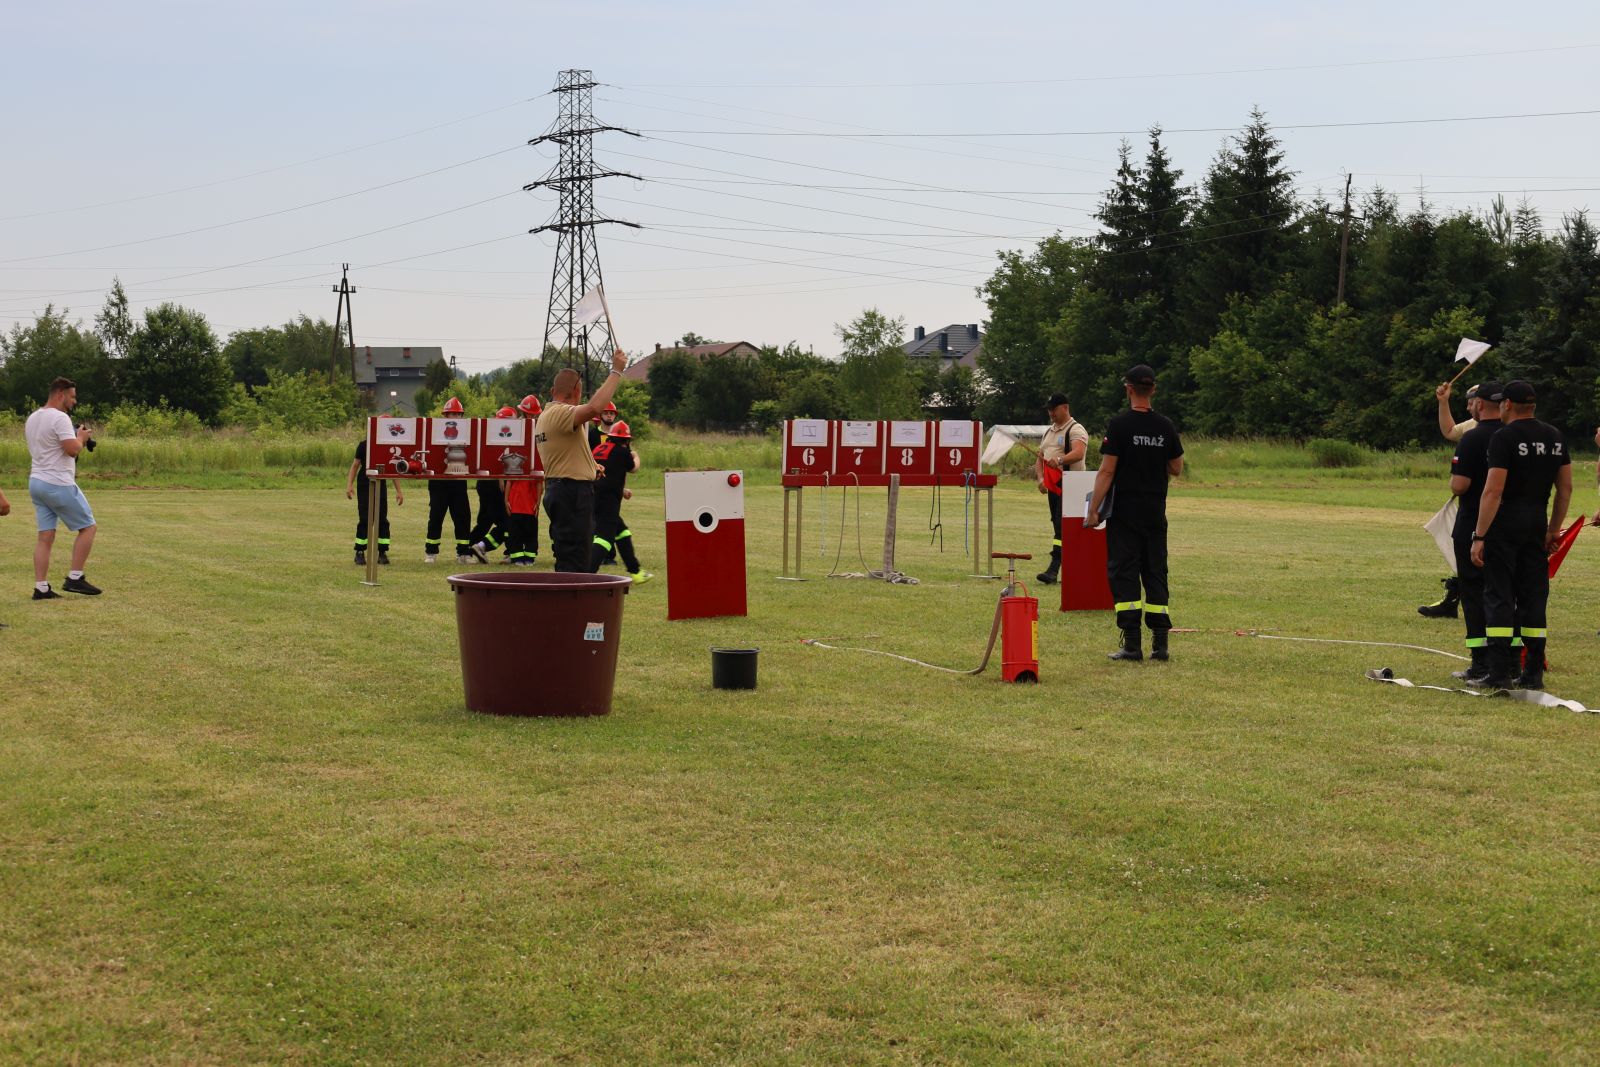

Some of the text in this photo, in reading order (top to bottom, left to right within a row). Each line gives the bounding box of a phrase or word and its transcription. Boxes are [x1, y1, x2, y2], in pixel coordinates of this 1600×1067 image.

[1133, 435, 1164, 447] STRAŻ
[595, 444, 608, 457] 2
[802, 448, 815, 466] 6
[853, 448, 864, 466] 7
[900, 448, 914, 466] 8
[949, 448, 962, 466] 9
